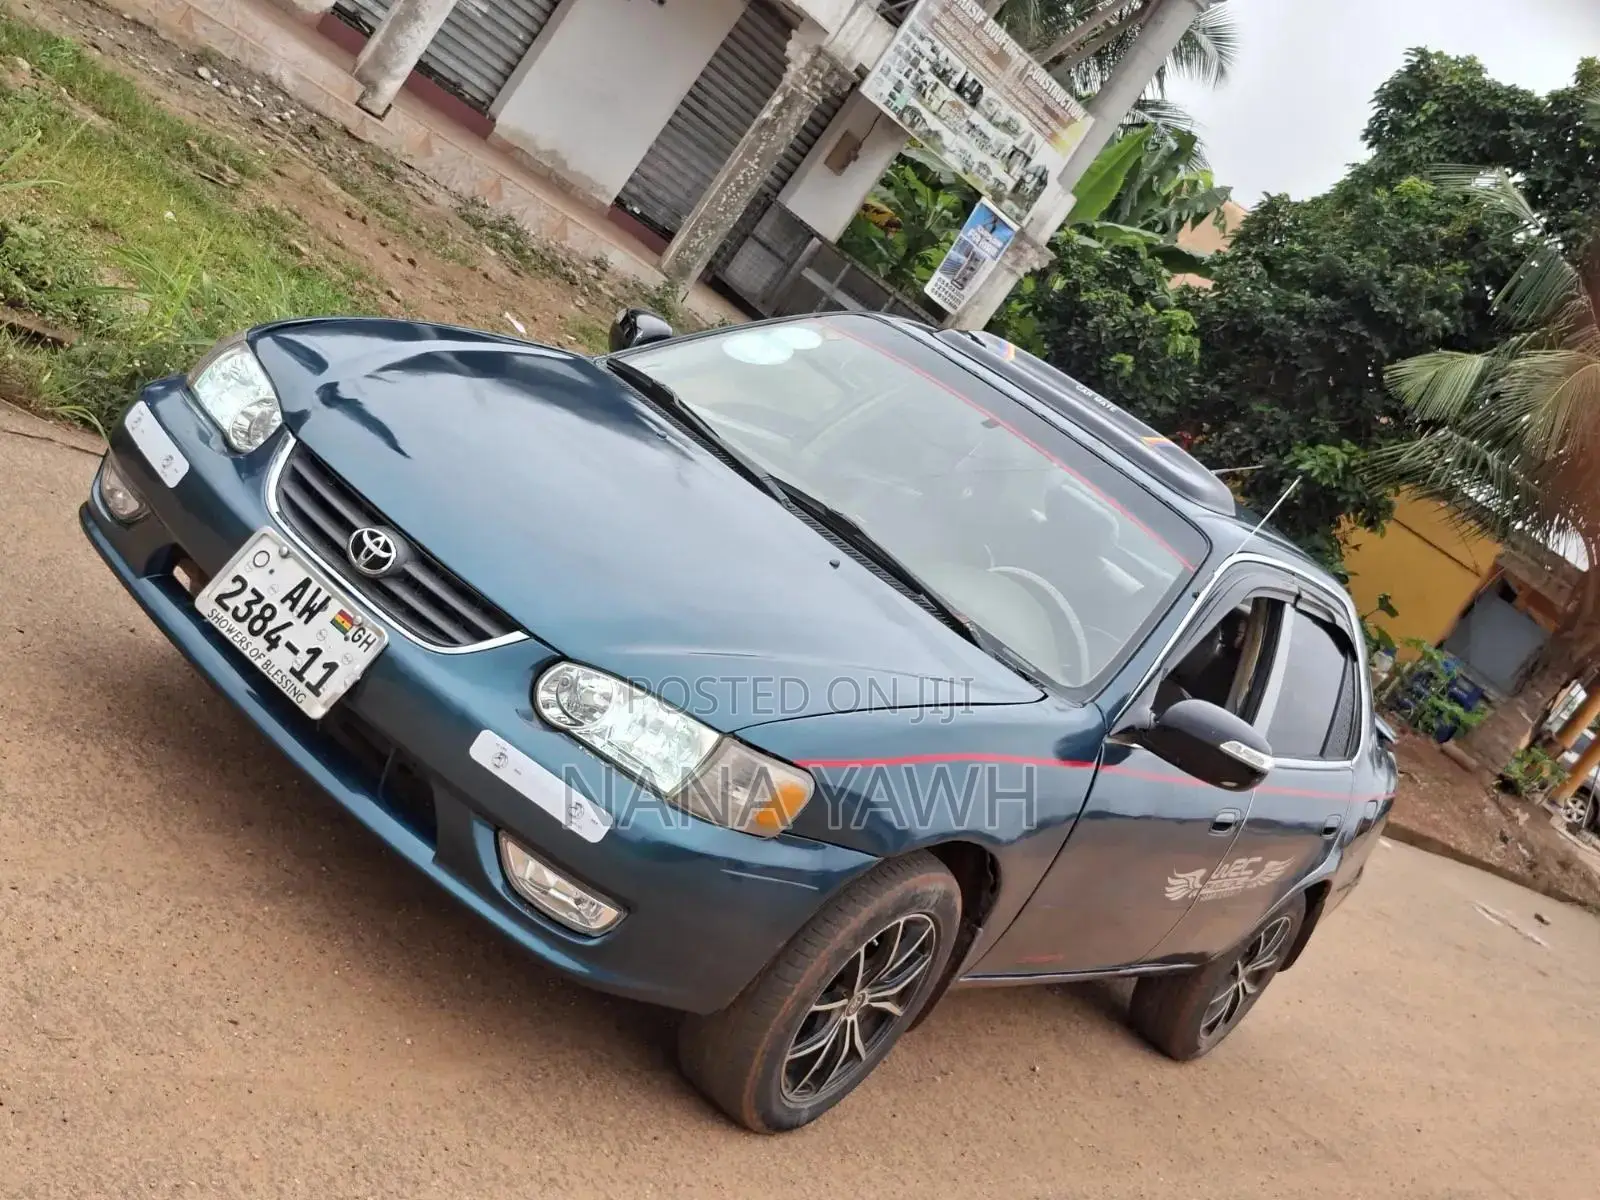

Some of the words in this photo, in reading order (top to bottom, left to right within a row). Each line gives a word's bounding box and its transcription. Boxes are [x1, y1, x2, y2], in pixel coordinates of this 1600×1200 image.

[214, 575, 340, 698] 2384-11
[280, 577, 332, 625] AW
[207, 608, 252, 651] SHOWERS
[249, 647, 265, 664] OF
[261, 658, 307, 704] BLESSING
[351, 627, 377, 653] GH
